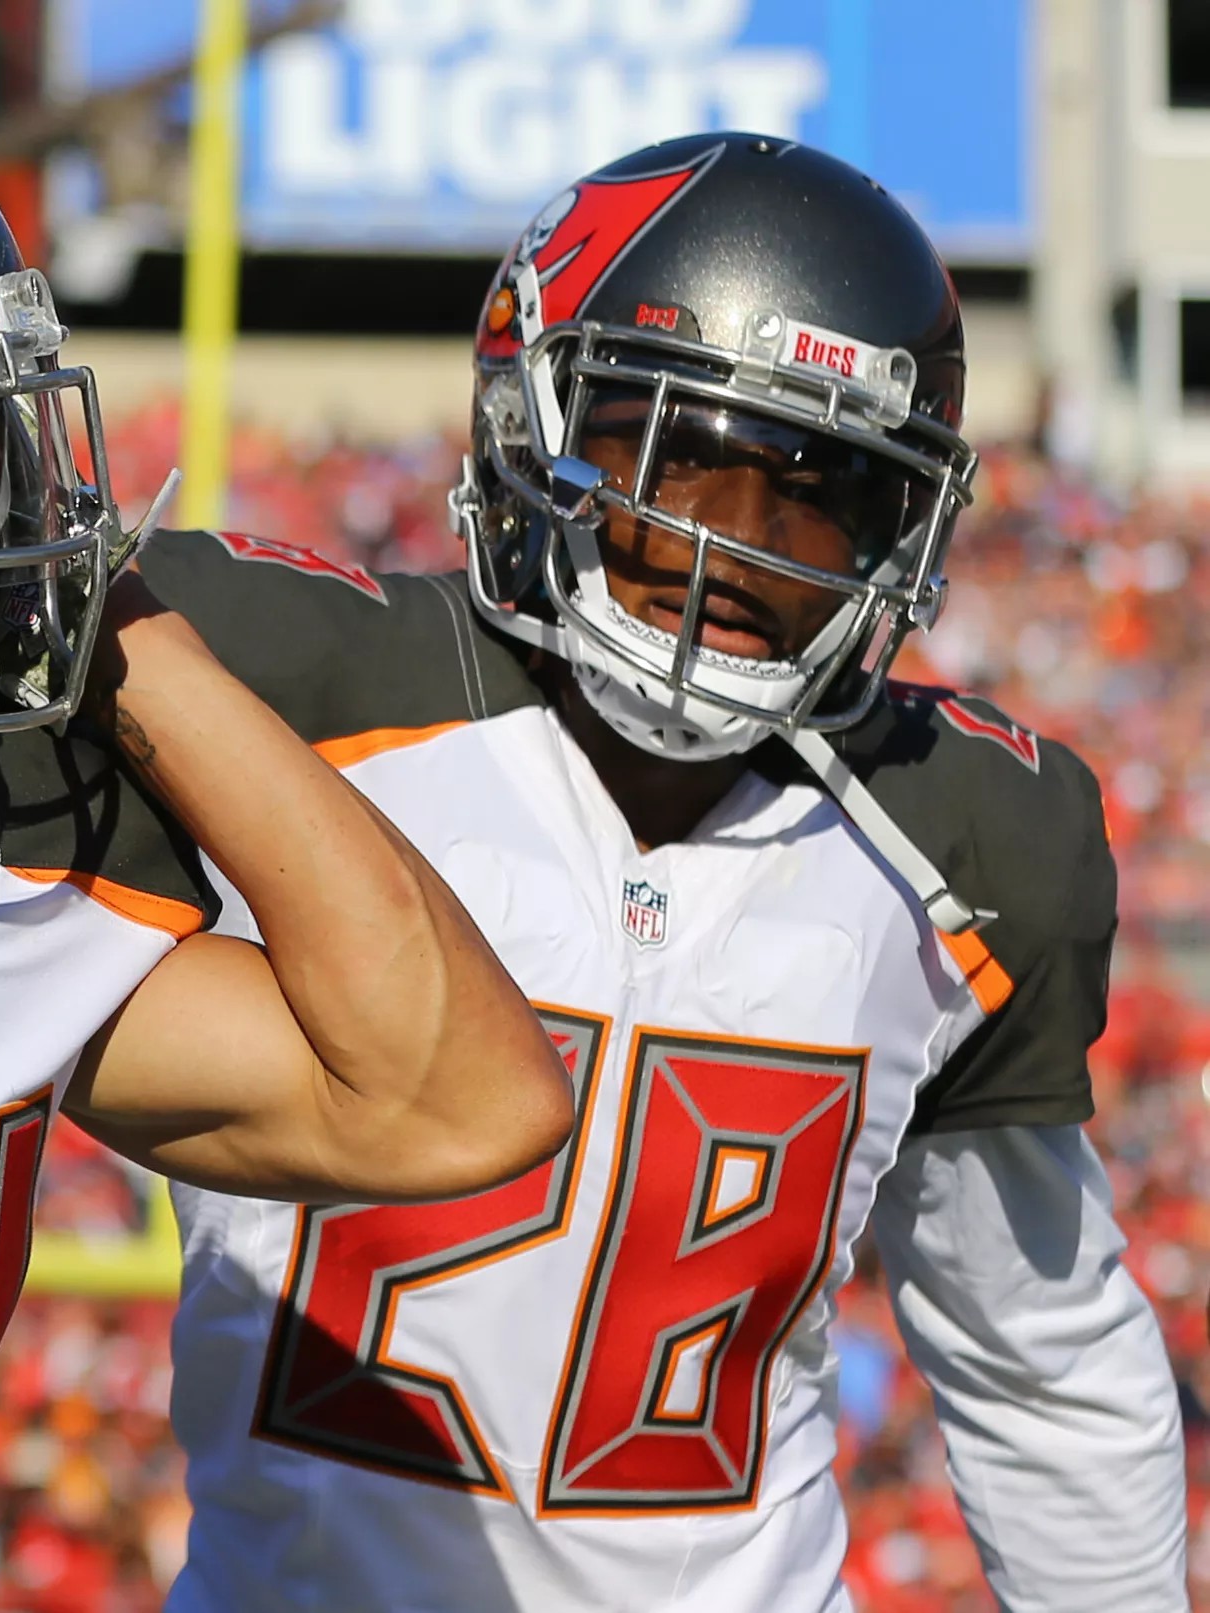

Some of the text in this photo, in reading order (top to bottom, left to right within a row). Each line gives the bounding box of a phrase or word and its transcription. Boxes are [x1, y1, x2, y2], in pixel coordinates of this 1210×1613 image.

[265, 38, 824, 195] LIGHT
[626, 903, 661, 939] NFL
[249, 1000, 873, 1521] 28
